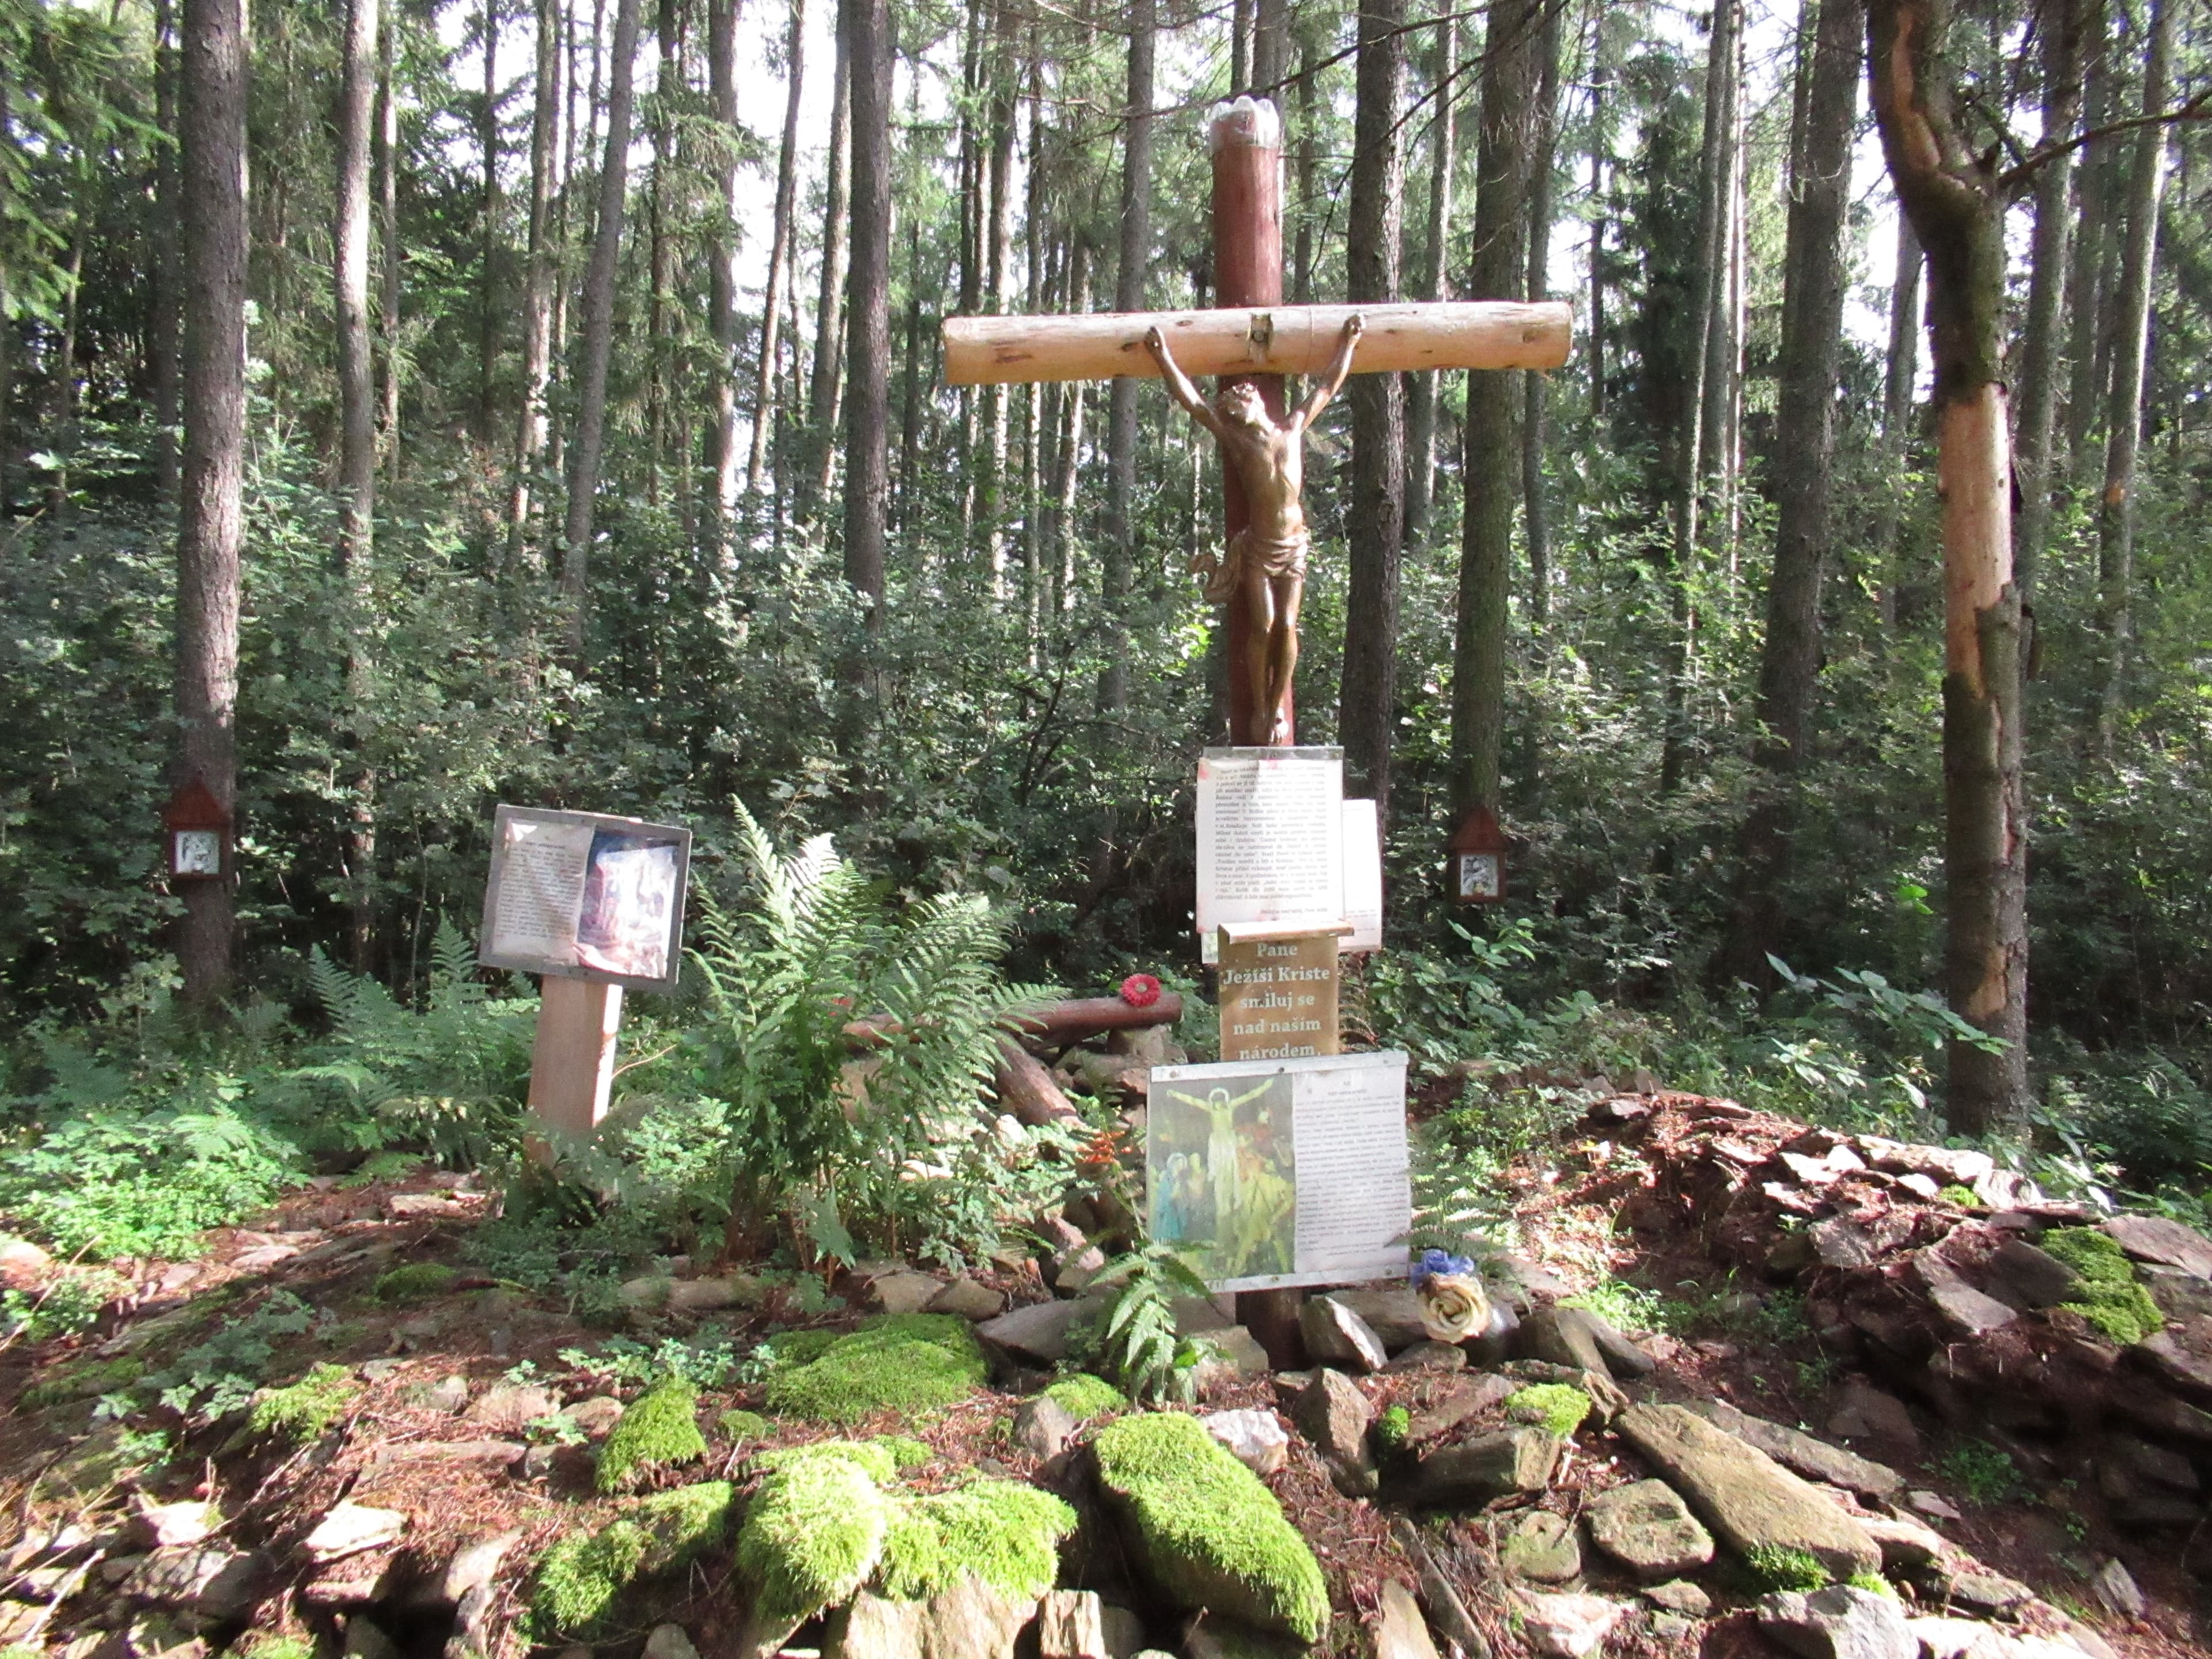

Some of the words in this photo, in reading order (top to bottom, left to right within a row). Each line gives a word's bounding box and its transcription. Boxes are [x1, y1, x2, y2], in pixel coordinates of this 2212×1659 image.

[1257, 943, 1298, 957] Pane
[1223, 967, 1273, 984] Ježíši
[1278, 965, 1330, 982] Kriste
[1240, 991, 1293, 1012] smiluj
[1297, 995, 1315, 1006] se
[1233, 1018, 1265, 1035] nad
